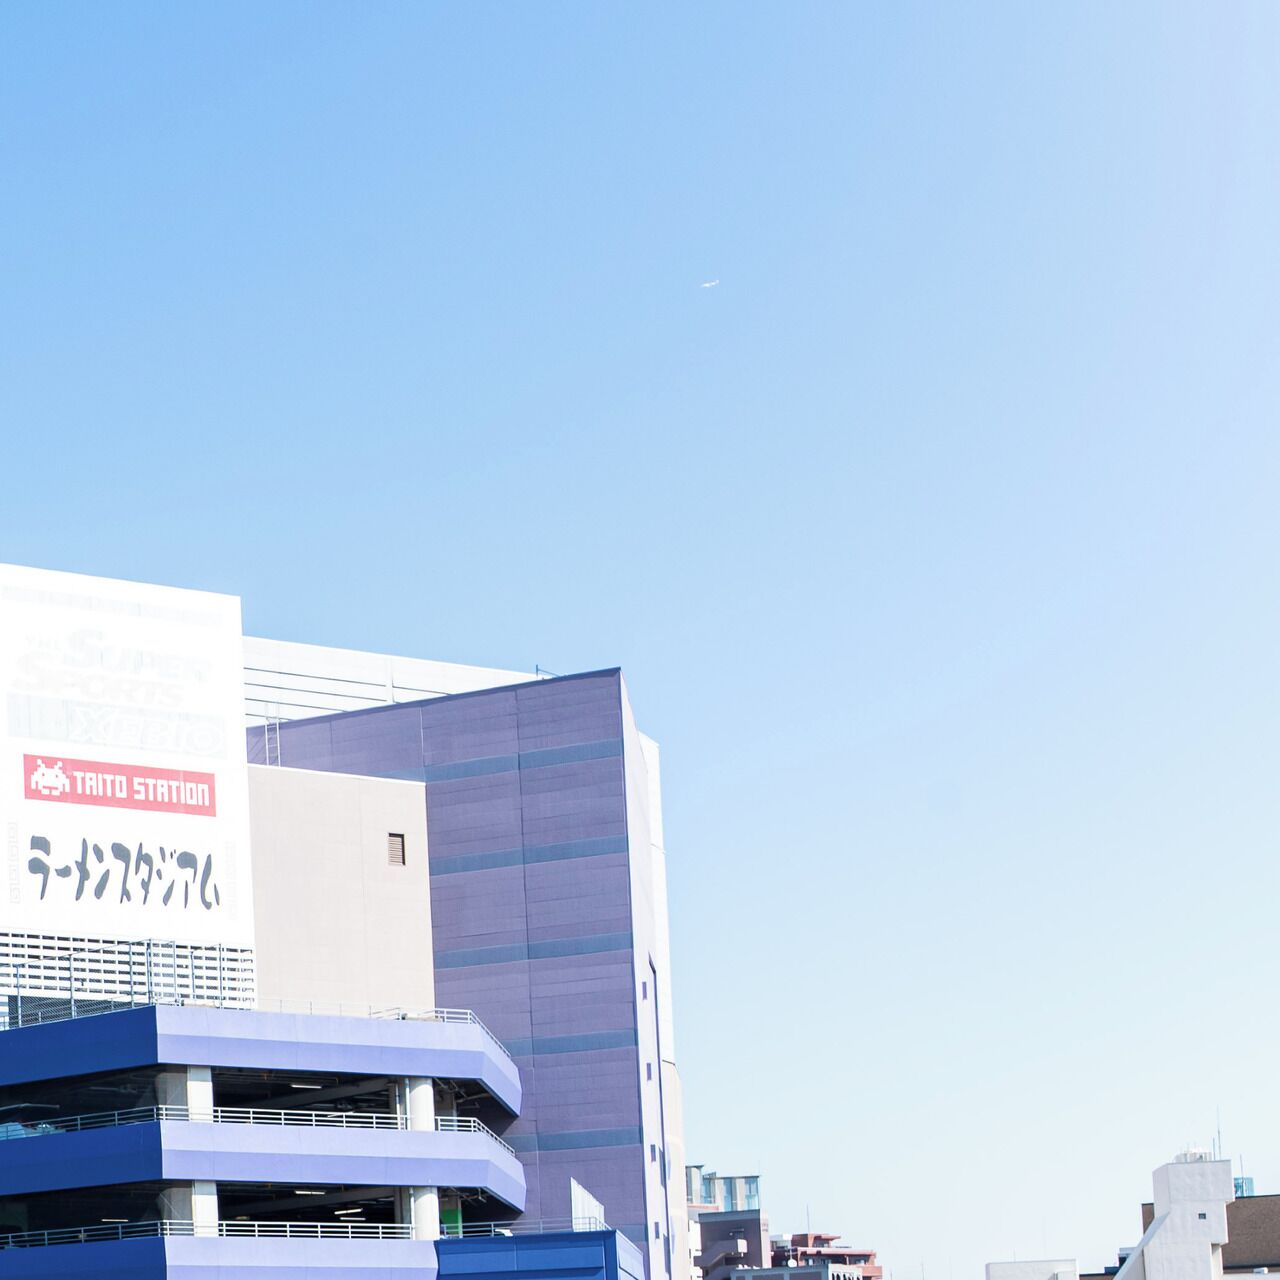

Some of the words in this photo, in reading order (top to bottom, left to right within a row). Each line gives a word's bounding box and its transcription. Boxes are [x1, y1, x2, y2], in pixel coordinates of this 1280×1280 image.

[73, 771, 127, 798] TAITO
[133, 777, 210, 806] STATION
[27, 834, 220, 910] ラーメンスタジアム
